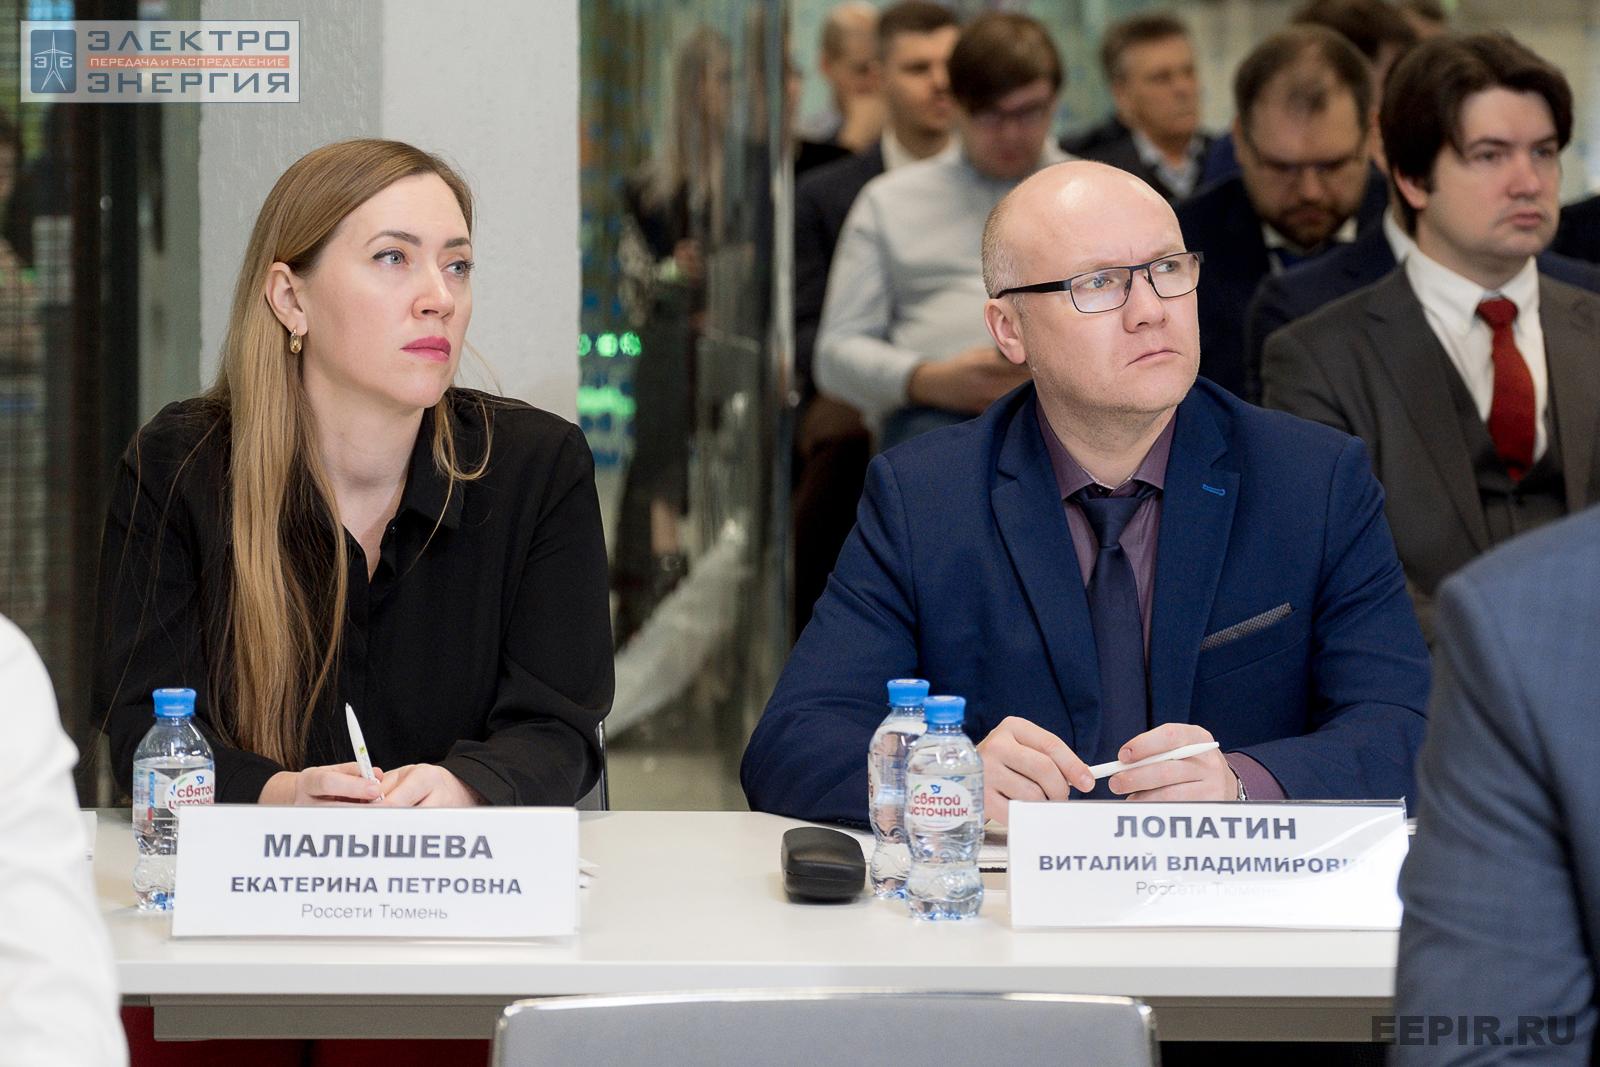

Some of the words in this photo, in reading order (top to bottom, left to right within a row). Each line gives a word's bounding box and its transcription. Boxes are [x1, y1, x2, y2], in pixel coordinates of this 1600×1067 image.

[1113, 815, 1297, 841] ЛОПАТИН
[263, 833, 494, 859] МАЛЫШЕВА
[1039, 851, 1157, 872] ВИТАЛИЙ
[1166, 855, 1366, 874] ВЛАДИМИРОВ
[230, 876, 379, 894] ЕКАТЕРИНА
[387, 877, 522, 895] ПЕТРОВНА
[301, 904, 373, 920] Россети
[379, 904, 449, 920] Тюмень
